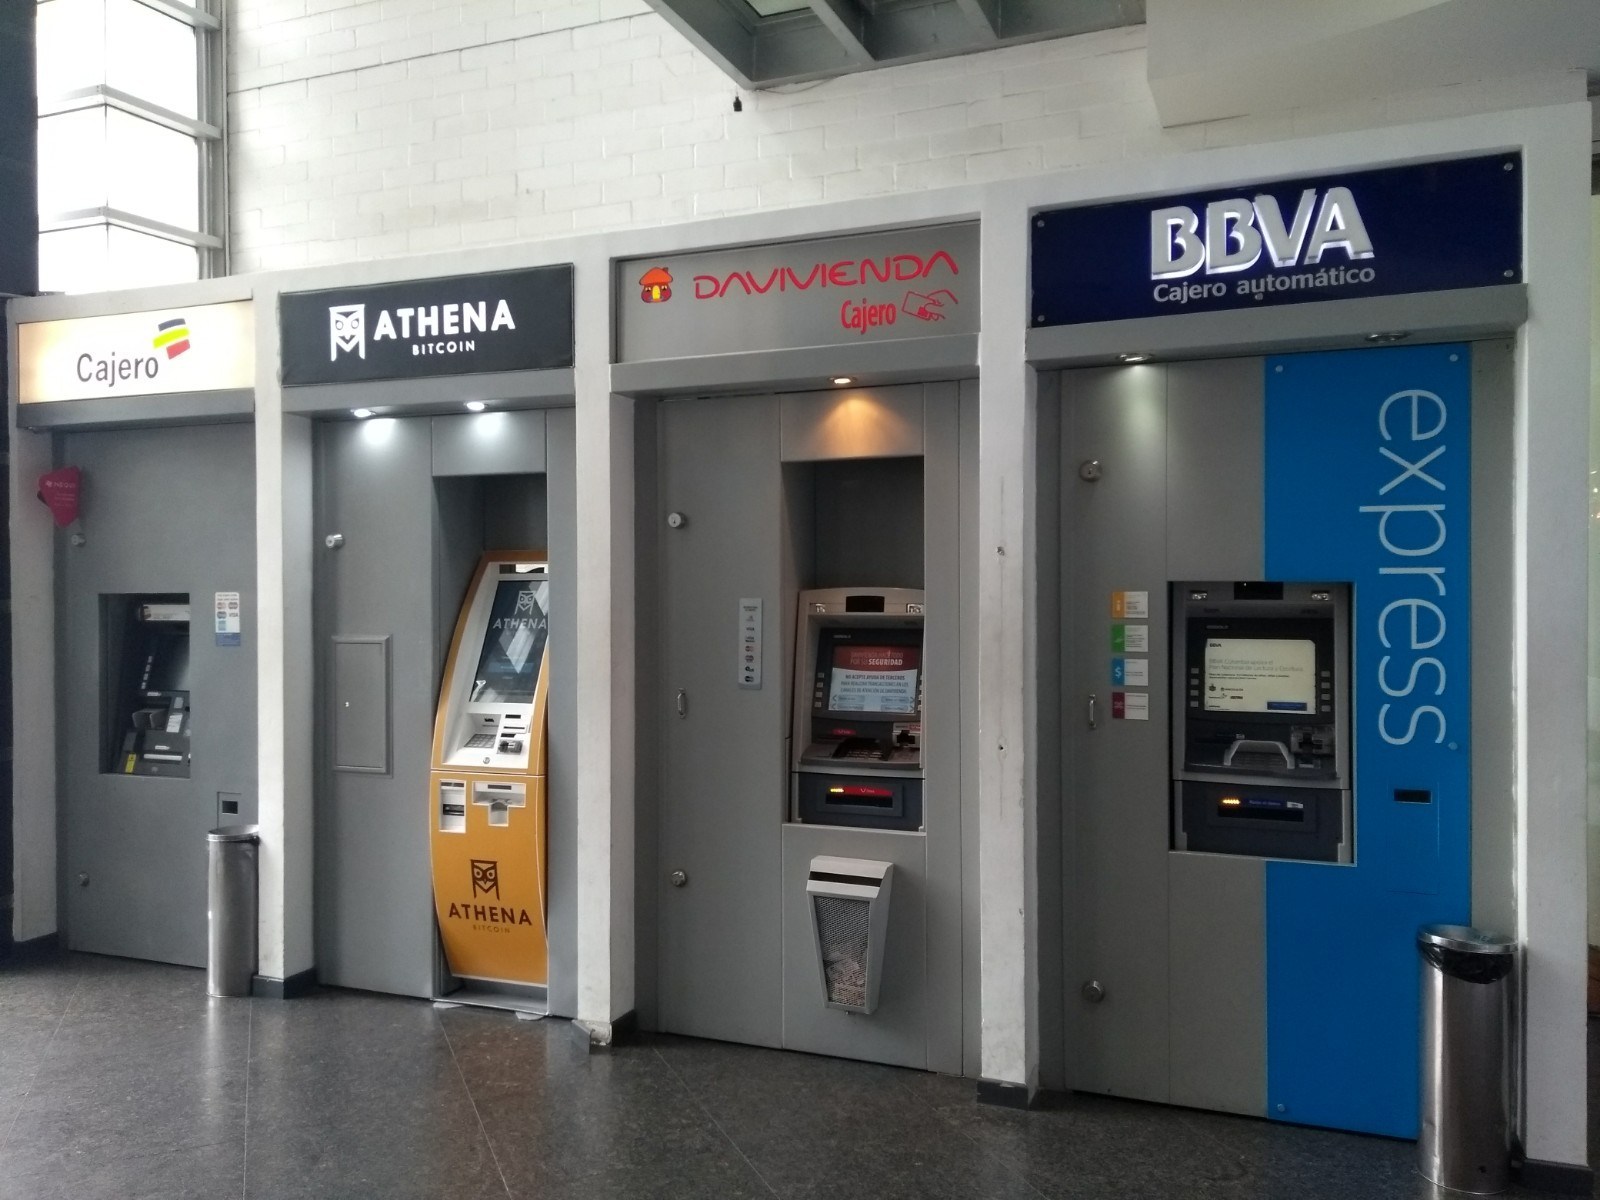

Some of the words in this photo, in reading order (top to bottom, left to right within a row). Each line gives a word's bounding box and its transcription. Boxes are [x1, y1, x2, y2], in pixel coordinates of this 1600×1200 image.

[1151, 186, 1375, 281] BBVA
[693, 250, 959, 299] DAVIVIENDA
[1153, 281, 1227, 304] Cajero
[1236, 266, 1376, 296] automático
[373, 299, 516, 341] ATHENA
[841, 298, 896, 334] Cajero
[412, 340, 475, 356] BITCOIN
[77, 351, 159, 388] Cajero
[1359, 389, 1447, 745] express
[492, 617, 547, 629] ATHENA
[448, 902, 532, 926] ATHENA
[472, 924, 511, 934] BITCOIN
